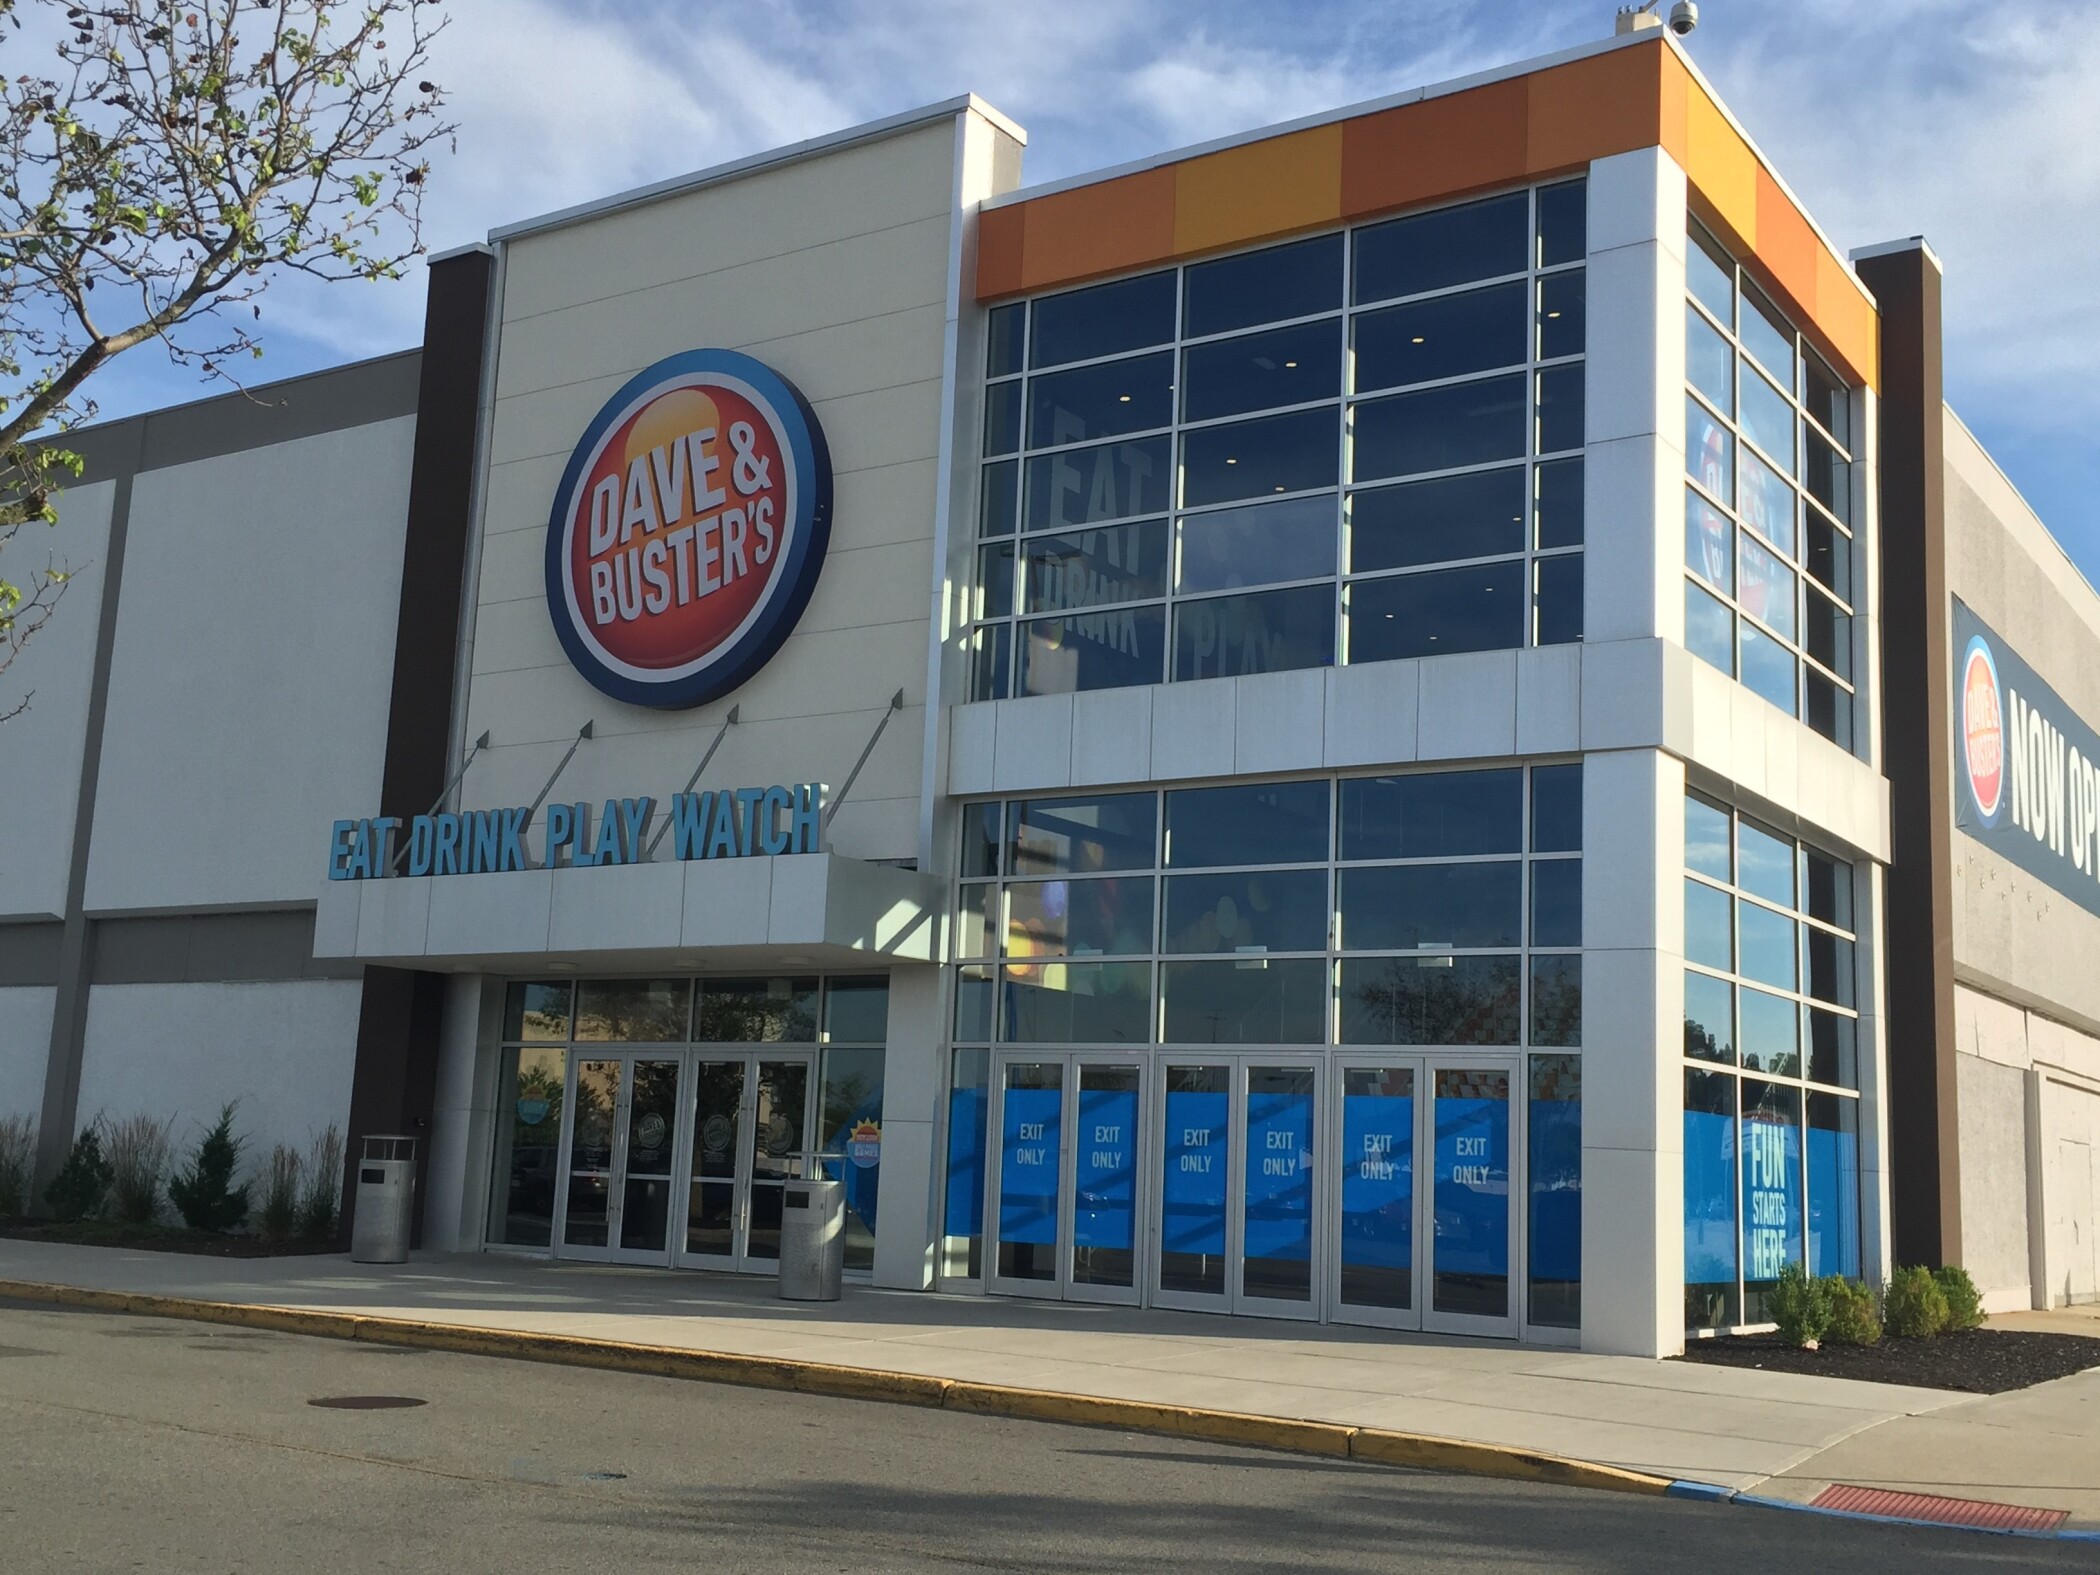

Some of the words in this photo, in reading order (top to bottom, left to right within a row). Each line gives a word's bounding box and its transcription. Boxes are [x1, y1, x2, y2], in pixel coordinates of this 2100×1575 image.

[589, 427, 726, 558] DAVE
[727, 421, 773, 495] &
[590, 496, 774, 625] BUSTER'S
[2009, 688, 2064, 857] NOW
[329, 818, 399, 880] EAT
[409, 807, 530, 877] DRINK
[545, 797, 652, 868] PLAY
[673, 783, 824, 861] WATCH
[1020, 1123, 1044, 1140] EXIT
[1095, 1126, 1120, 1143] EXIT
[1184, 1129, 1210, 1146] EXIT
[1266, 1131, 1294, 1150] EXIT
[1364, 1134, 1393, 1153] EXIT
[1456, 1137, 1486, 1156] EXIT
[1017, 1148, 1045, 1165] ONLY
[1092, 1152, 1121, 1169] ONLY
[1180, 1155, 1212, 1173] ONLY
[1751, 1122, 1785, 1189] FUN
[1263, 1158, 1296, 1176] ONLY
[1360, 1161, 1394, 1180] ONLY
[1453, 1165, 1489, 1185] ONLY
[1753, 1191, 1786, 1225] STARTS
